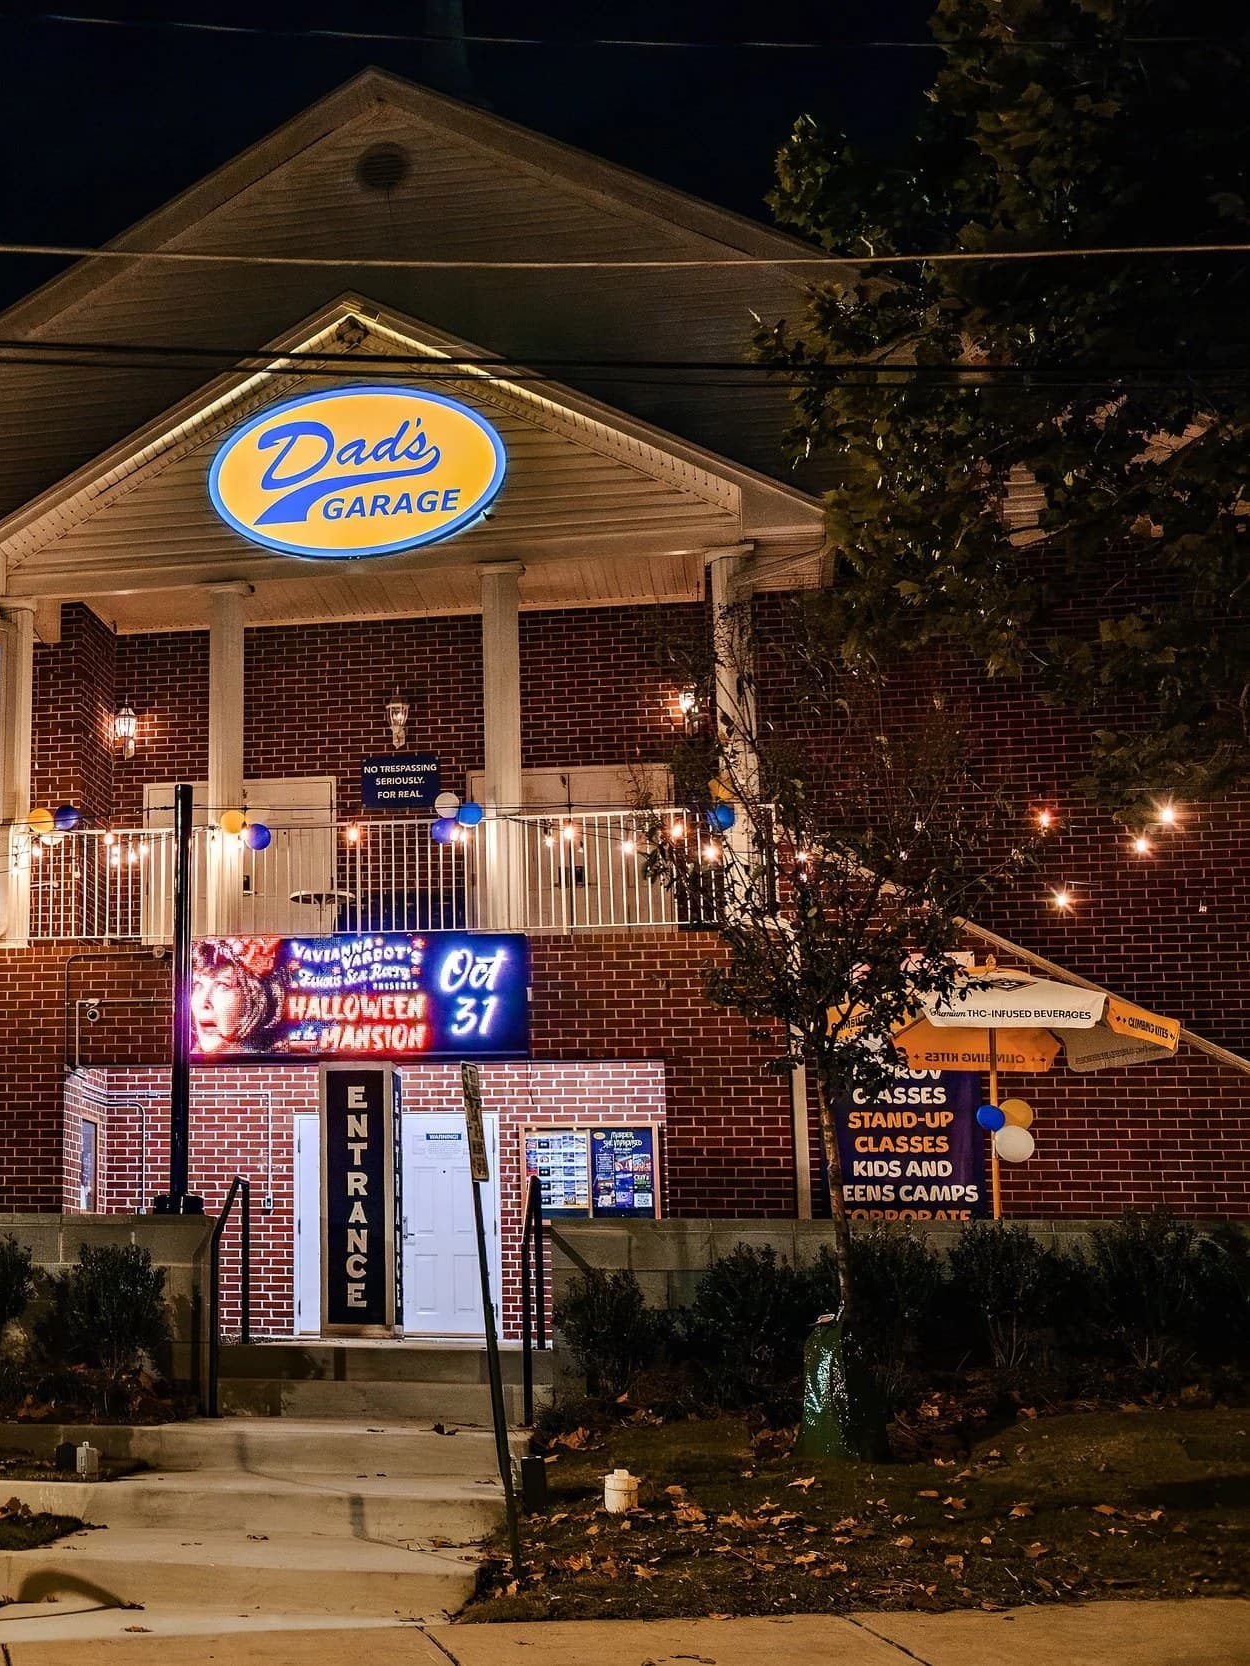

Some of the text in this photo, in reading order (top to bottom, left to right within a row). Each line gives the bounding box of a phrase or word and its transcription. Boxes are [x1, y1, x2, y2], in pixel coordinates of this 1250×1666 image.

[258, 418, 434, 490] Dad's
[323, 488, 461, 520] GARAGE
[364, 763, 438, 774] NO TRESPASSING
[375, 776, 425, 786] SERIOUSLY.
[377, 790, 424, 799] FOR REAL.
[439, 948, 507, 992] Oct
[288, 994, 426, 1020] HALLOWEEN
[451, 995, 498, 1035] 31
[967, 1009, 1032, 1018] THC-INFUSED
[1034, 1009, 1092, 1020] BEVERAGES
[320, 1023, 426, 1050] MANSION
[852, 1087, 947, 1105] CASSES
[848, 1112, 954, 1129] STAND-UP
[854, 1135, 949, 1154] CLASSES
[853, 1160, 953, 1177] KIDS AND
[345, 1086, 368, 1308] ENTRANCE
[842, 1185, 979, 1202] EENS CAMPS
